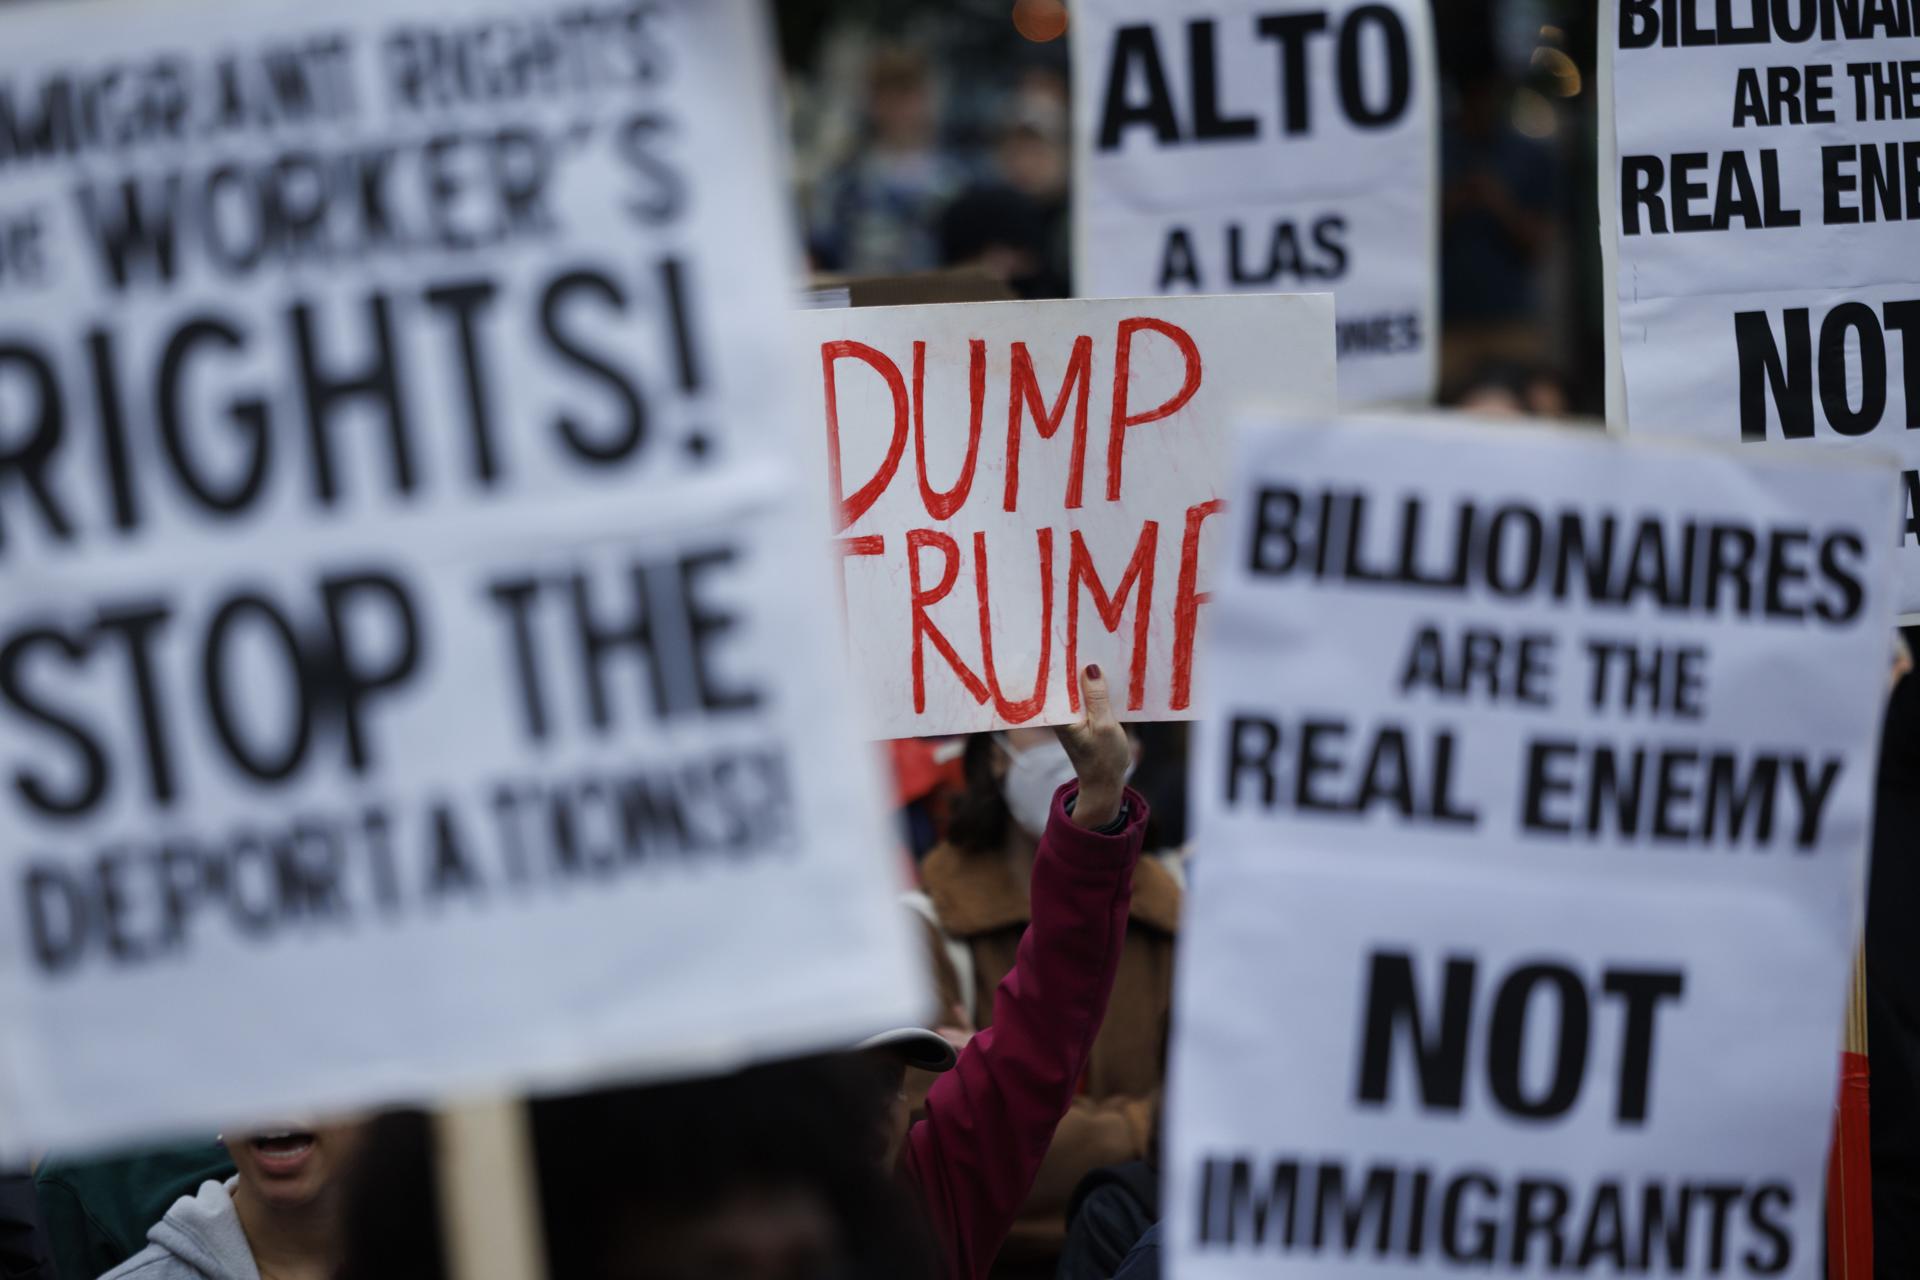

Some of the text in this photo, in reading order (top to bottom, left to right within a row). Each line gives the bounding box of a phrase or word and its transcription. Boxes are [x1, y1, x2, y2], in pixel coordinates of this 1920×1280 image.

[1097, 4, 1412, 151] ALTO
[1619, 0, 1920, 49] BILLIONAI
[1733, 60, 1920, 128] ARE THE
[1159, 214, 1349, 290] A LAS
[1622, 149, 1801, 236] REAL
[0, 250, 715, 552] RIGHTS!
[821, 316, 1202, 534] DUMP
[1734, 301, 1920, 443] NOT
[1247, 485, 1868, 630] BILLIONAIRES
[0, 544, 765, 822] STOP THE
[1400, 623, 1708, 724] ARE THE
[1222, 714, 1844, 854] REAL ENEMY
[1355, 948, 1686, 1128] NOT
[1198, 1156, 1796, 1278] IMMIGRANTS
